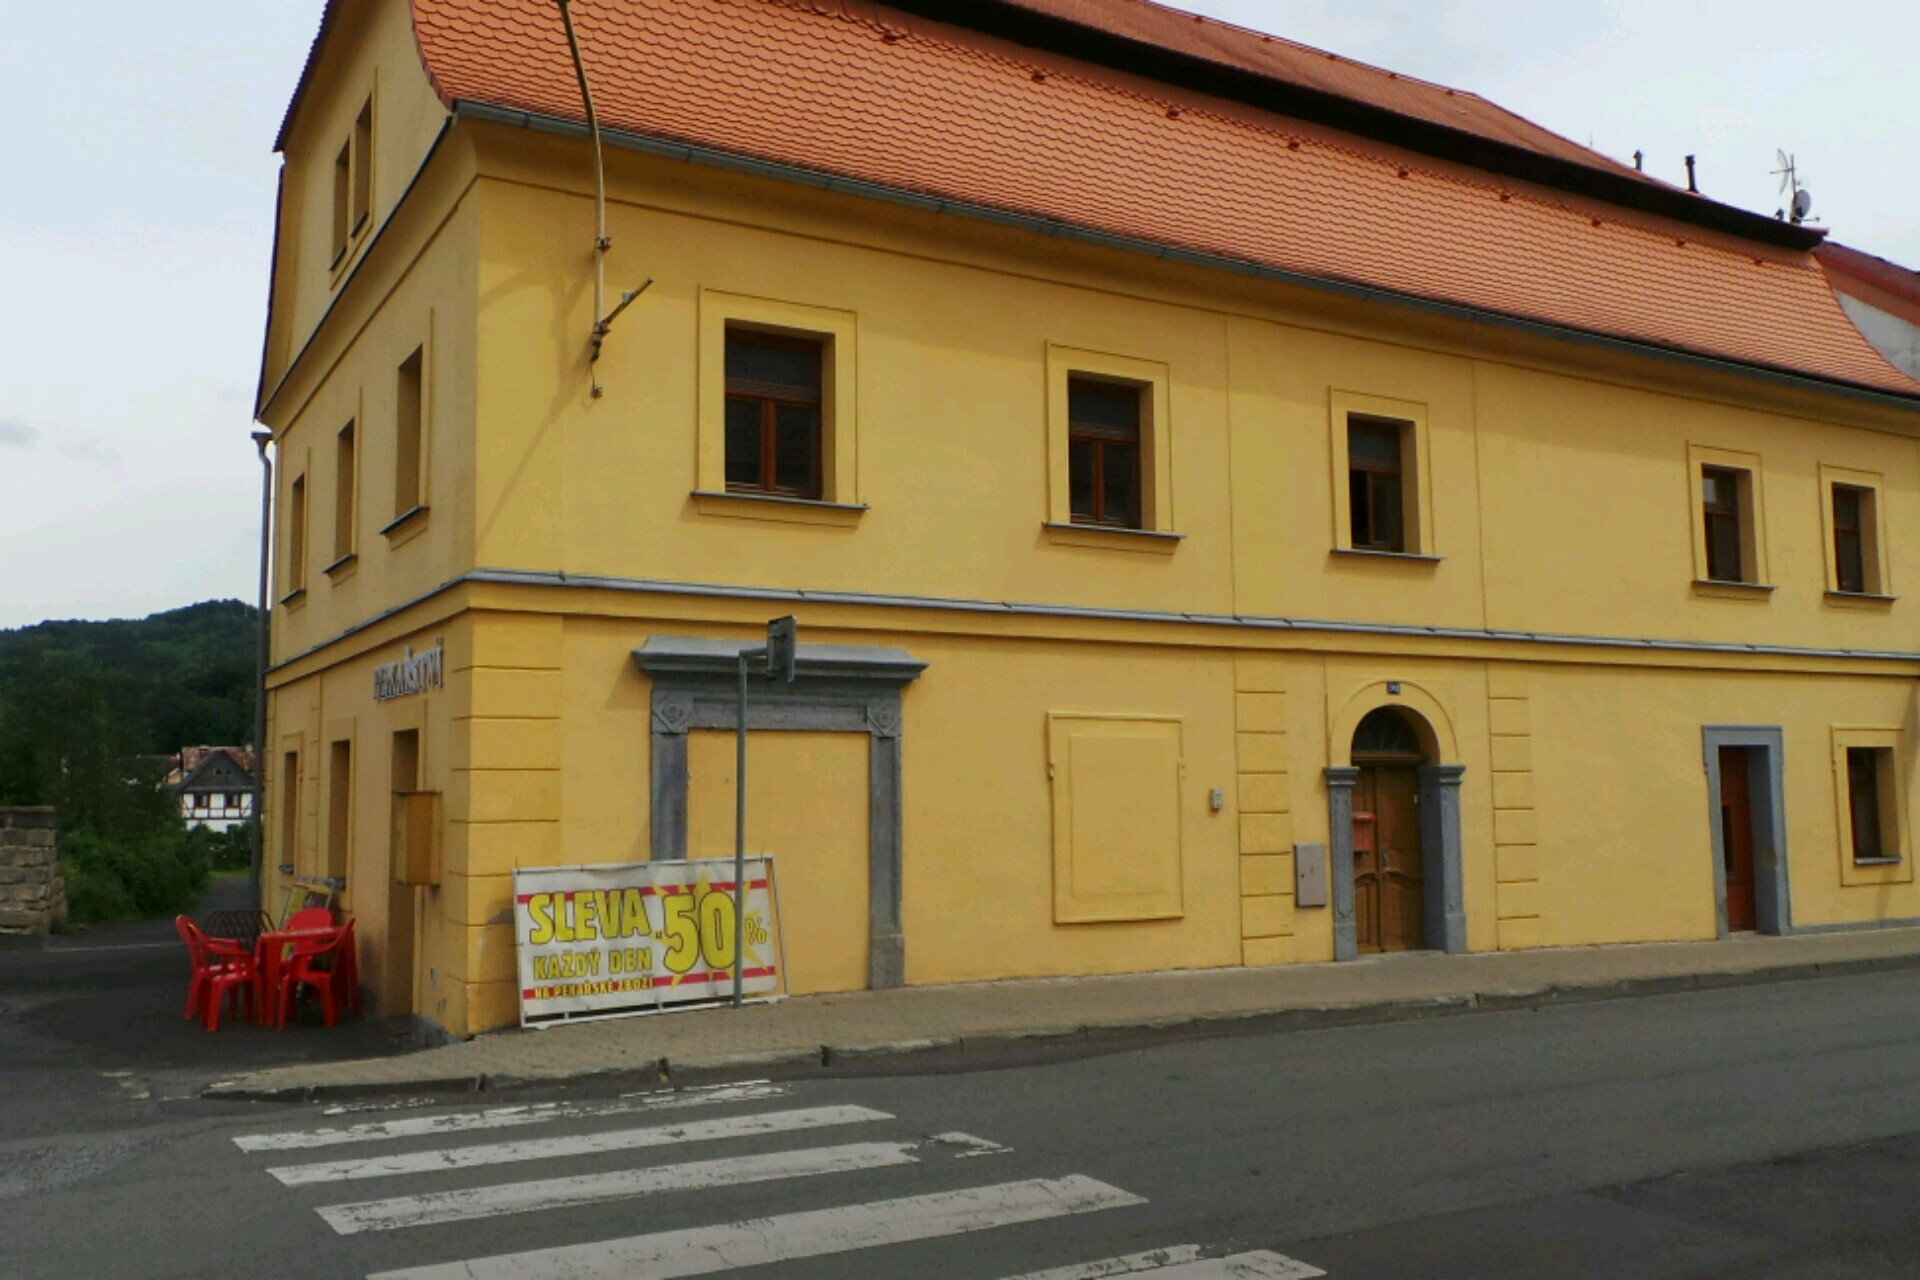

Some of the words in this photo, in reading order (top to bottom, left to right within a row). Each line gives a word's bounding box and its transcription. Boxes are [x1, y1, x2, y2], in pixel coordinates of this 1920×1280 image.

[528, 888, 651, 943] SLEVA
[533, 947, 600, 980] KAŽDÝ
[608, 947, 652, 974] DEN
[534, 985, 550, 999] NA
